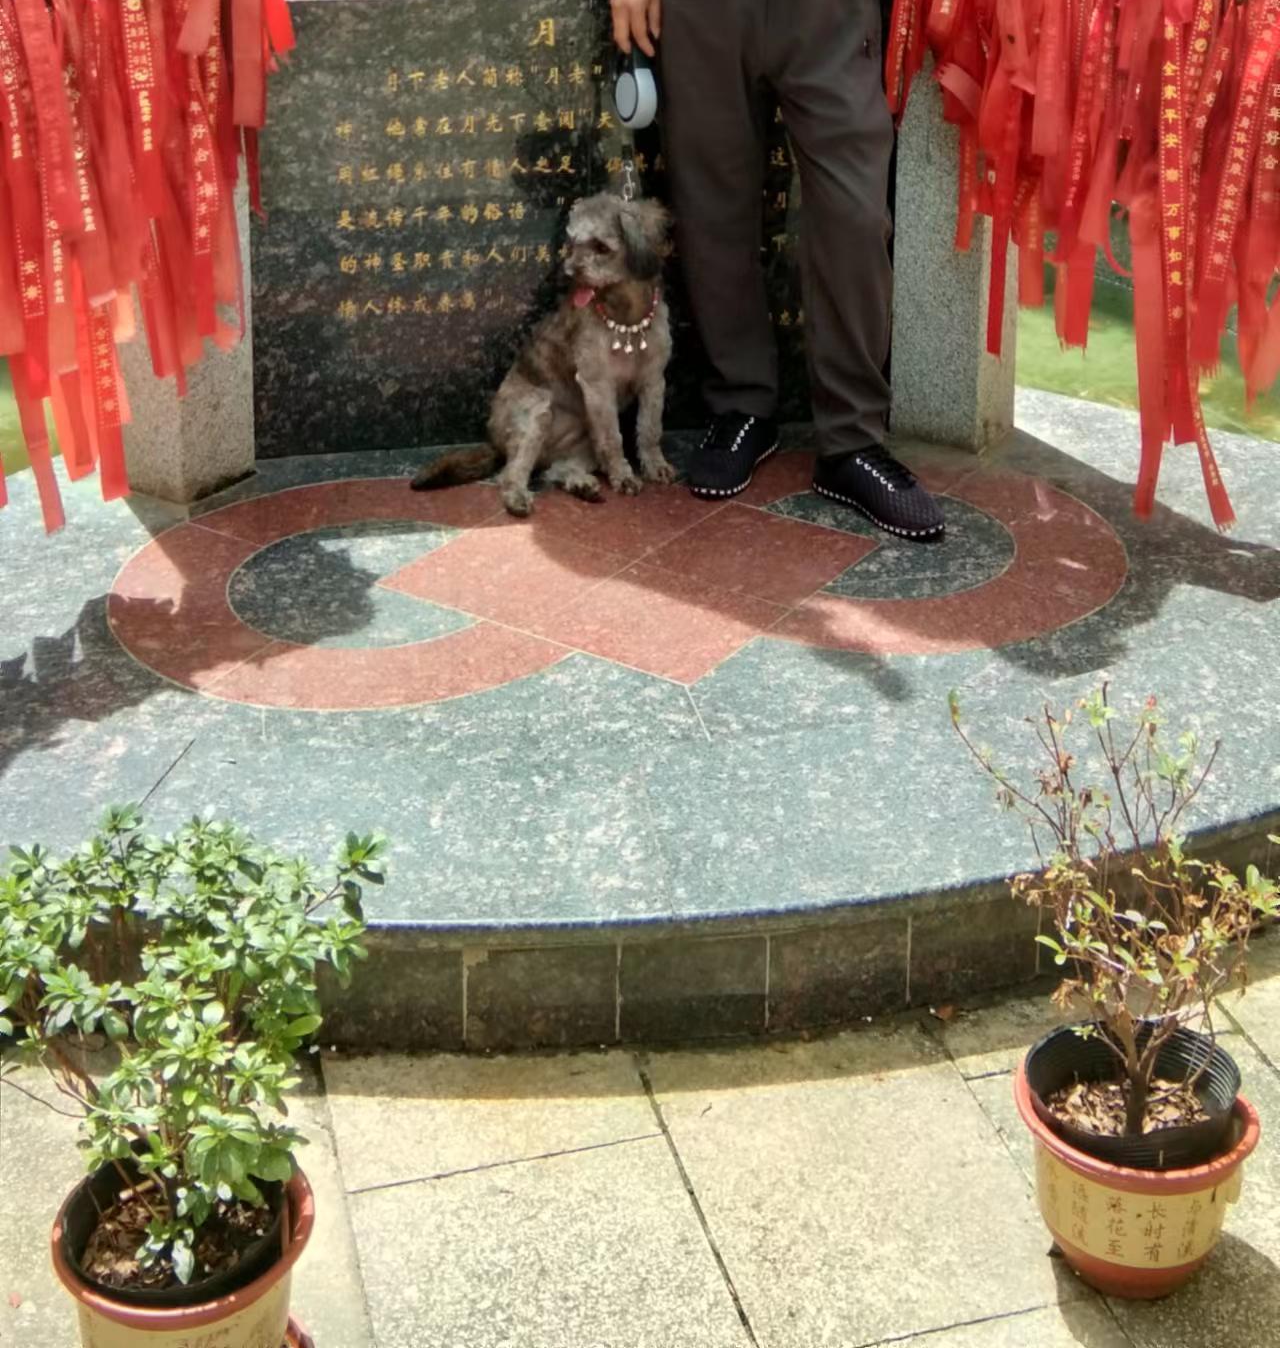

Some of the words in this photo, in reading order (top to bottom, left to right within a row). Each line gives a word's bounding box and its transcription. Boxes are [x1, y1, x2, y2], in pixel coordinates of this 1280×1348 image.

[530, 19, 557, 48] 月
[1162, 61, 1181, 148] 全家平安
